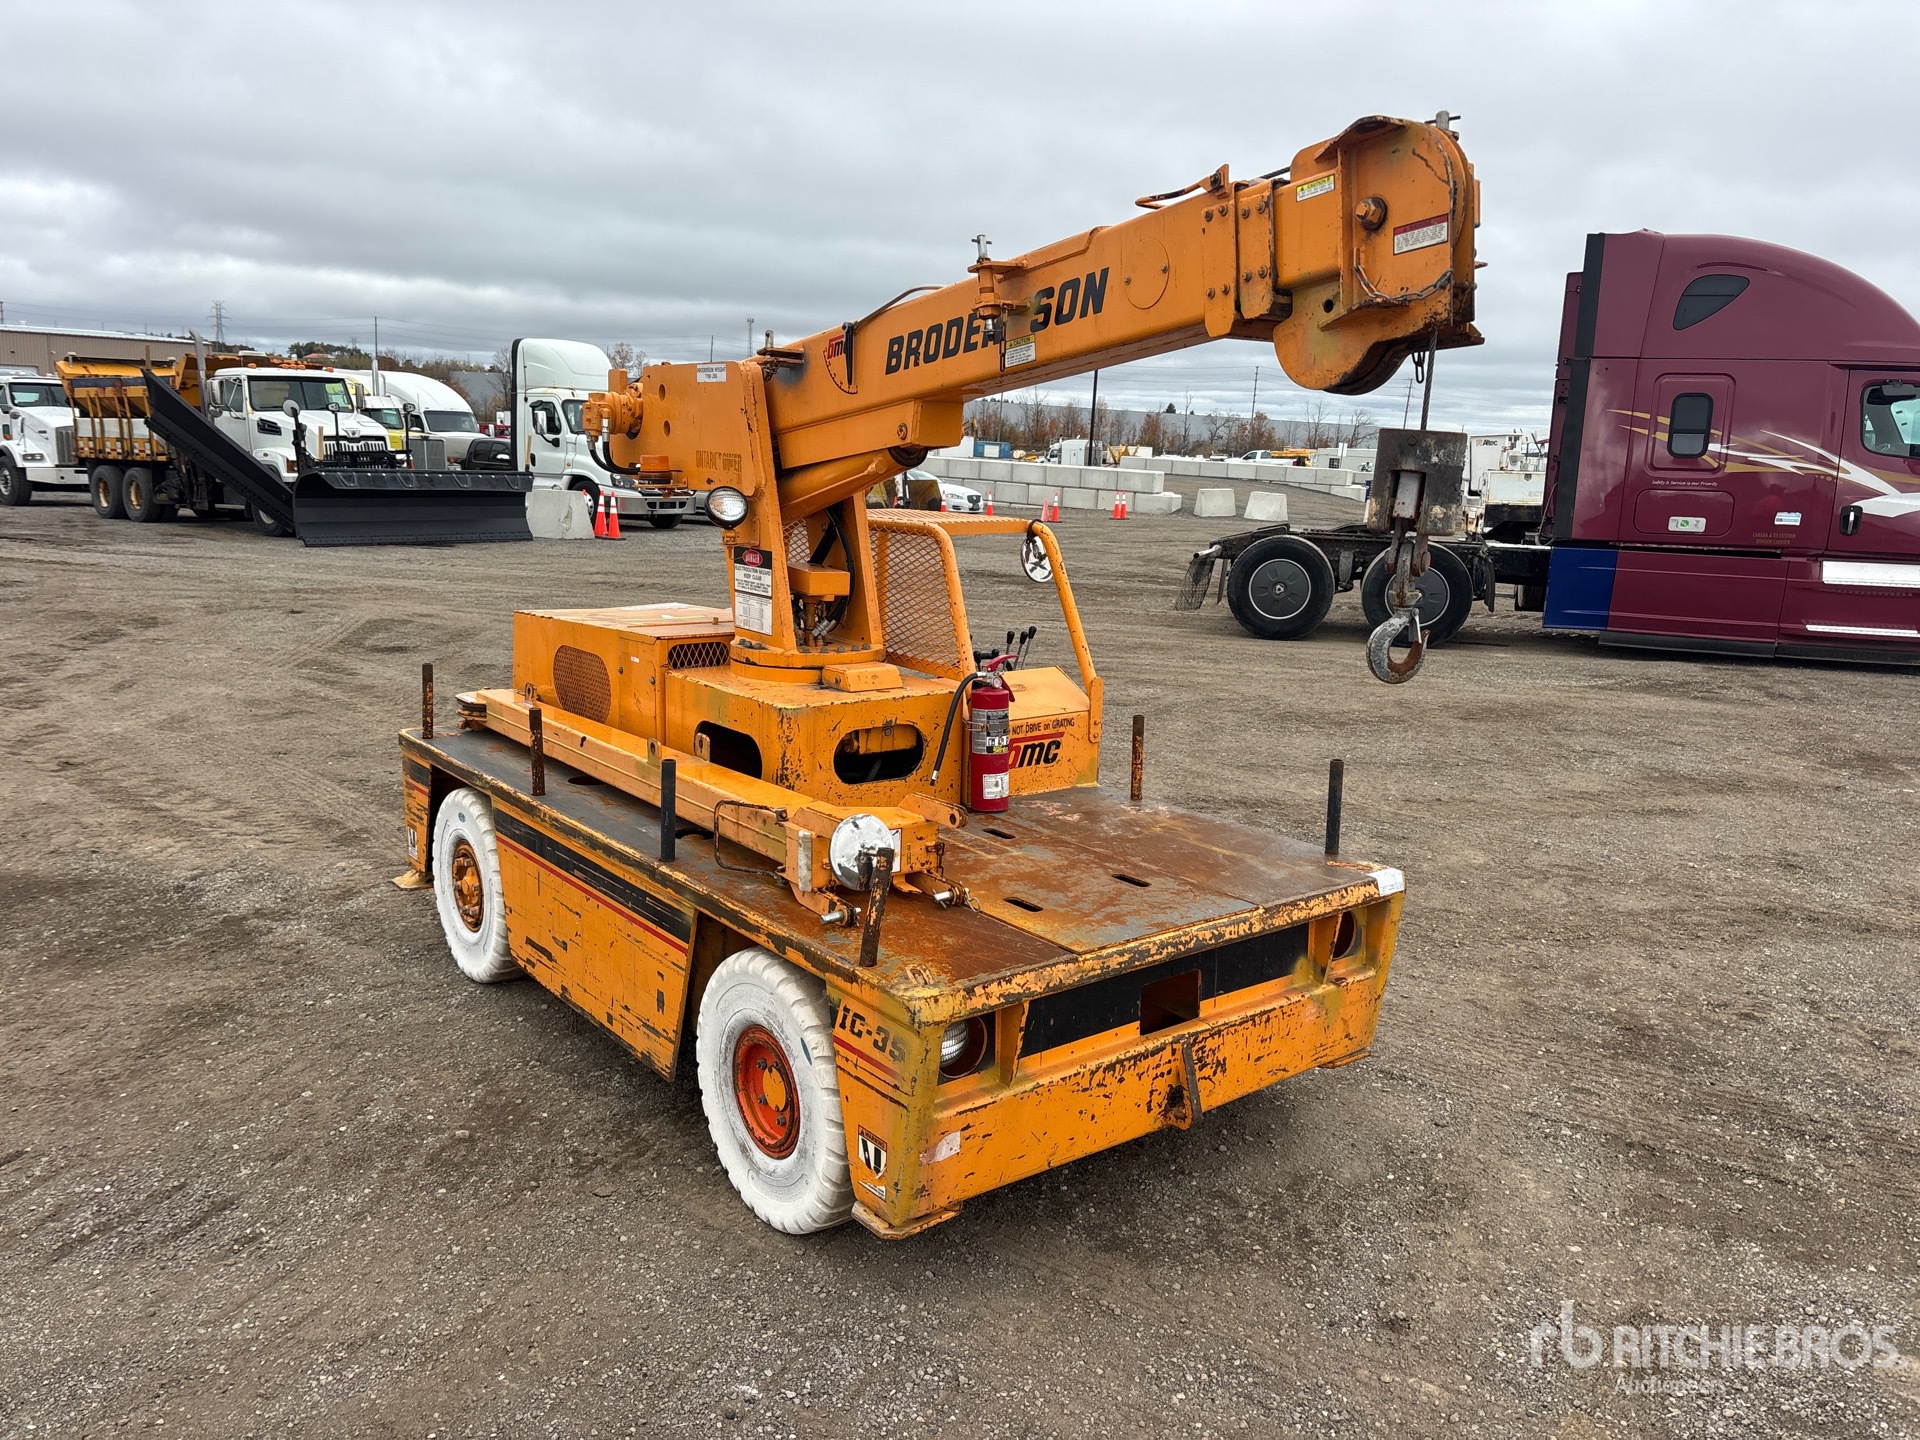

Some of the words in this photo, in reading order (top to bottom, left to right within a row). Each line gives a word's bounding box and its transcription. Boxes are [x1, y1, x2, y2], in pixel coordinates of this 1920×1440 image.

[1012, 337, 1030, 347] CAUTION
[745, 552, 760, 564] DANGER
[1012, 725, 1024, 735] NOT
[1052, 718, 1075, 729] GRATING
[839, 1006, 905, 1062] IC-35
[865, 1131, 885, 1148] WARNING
